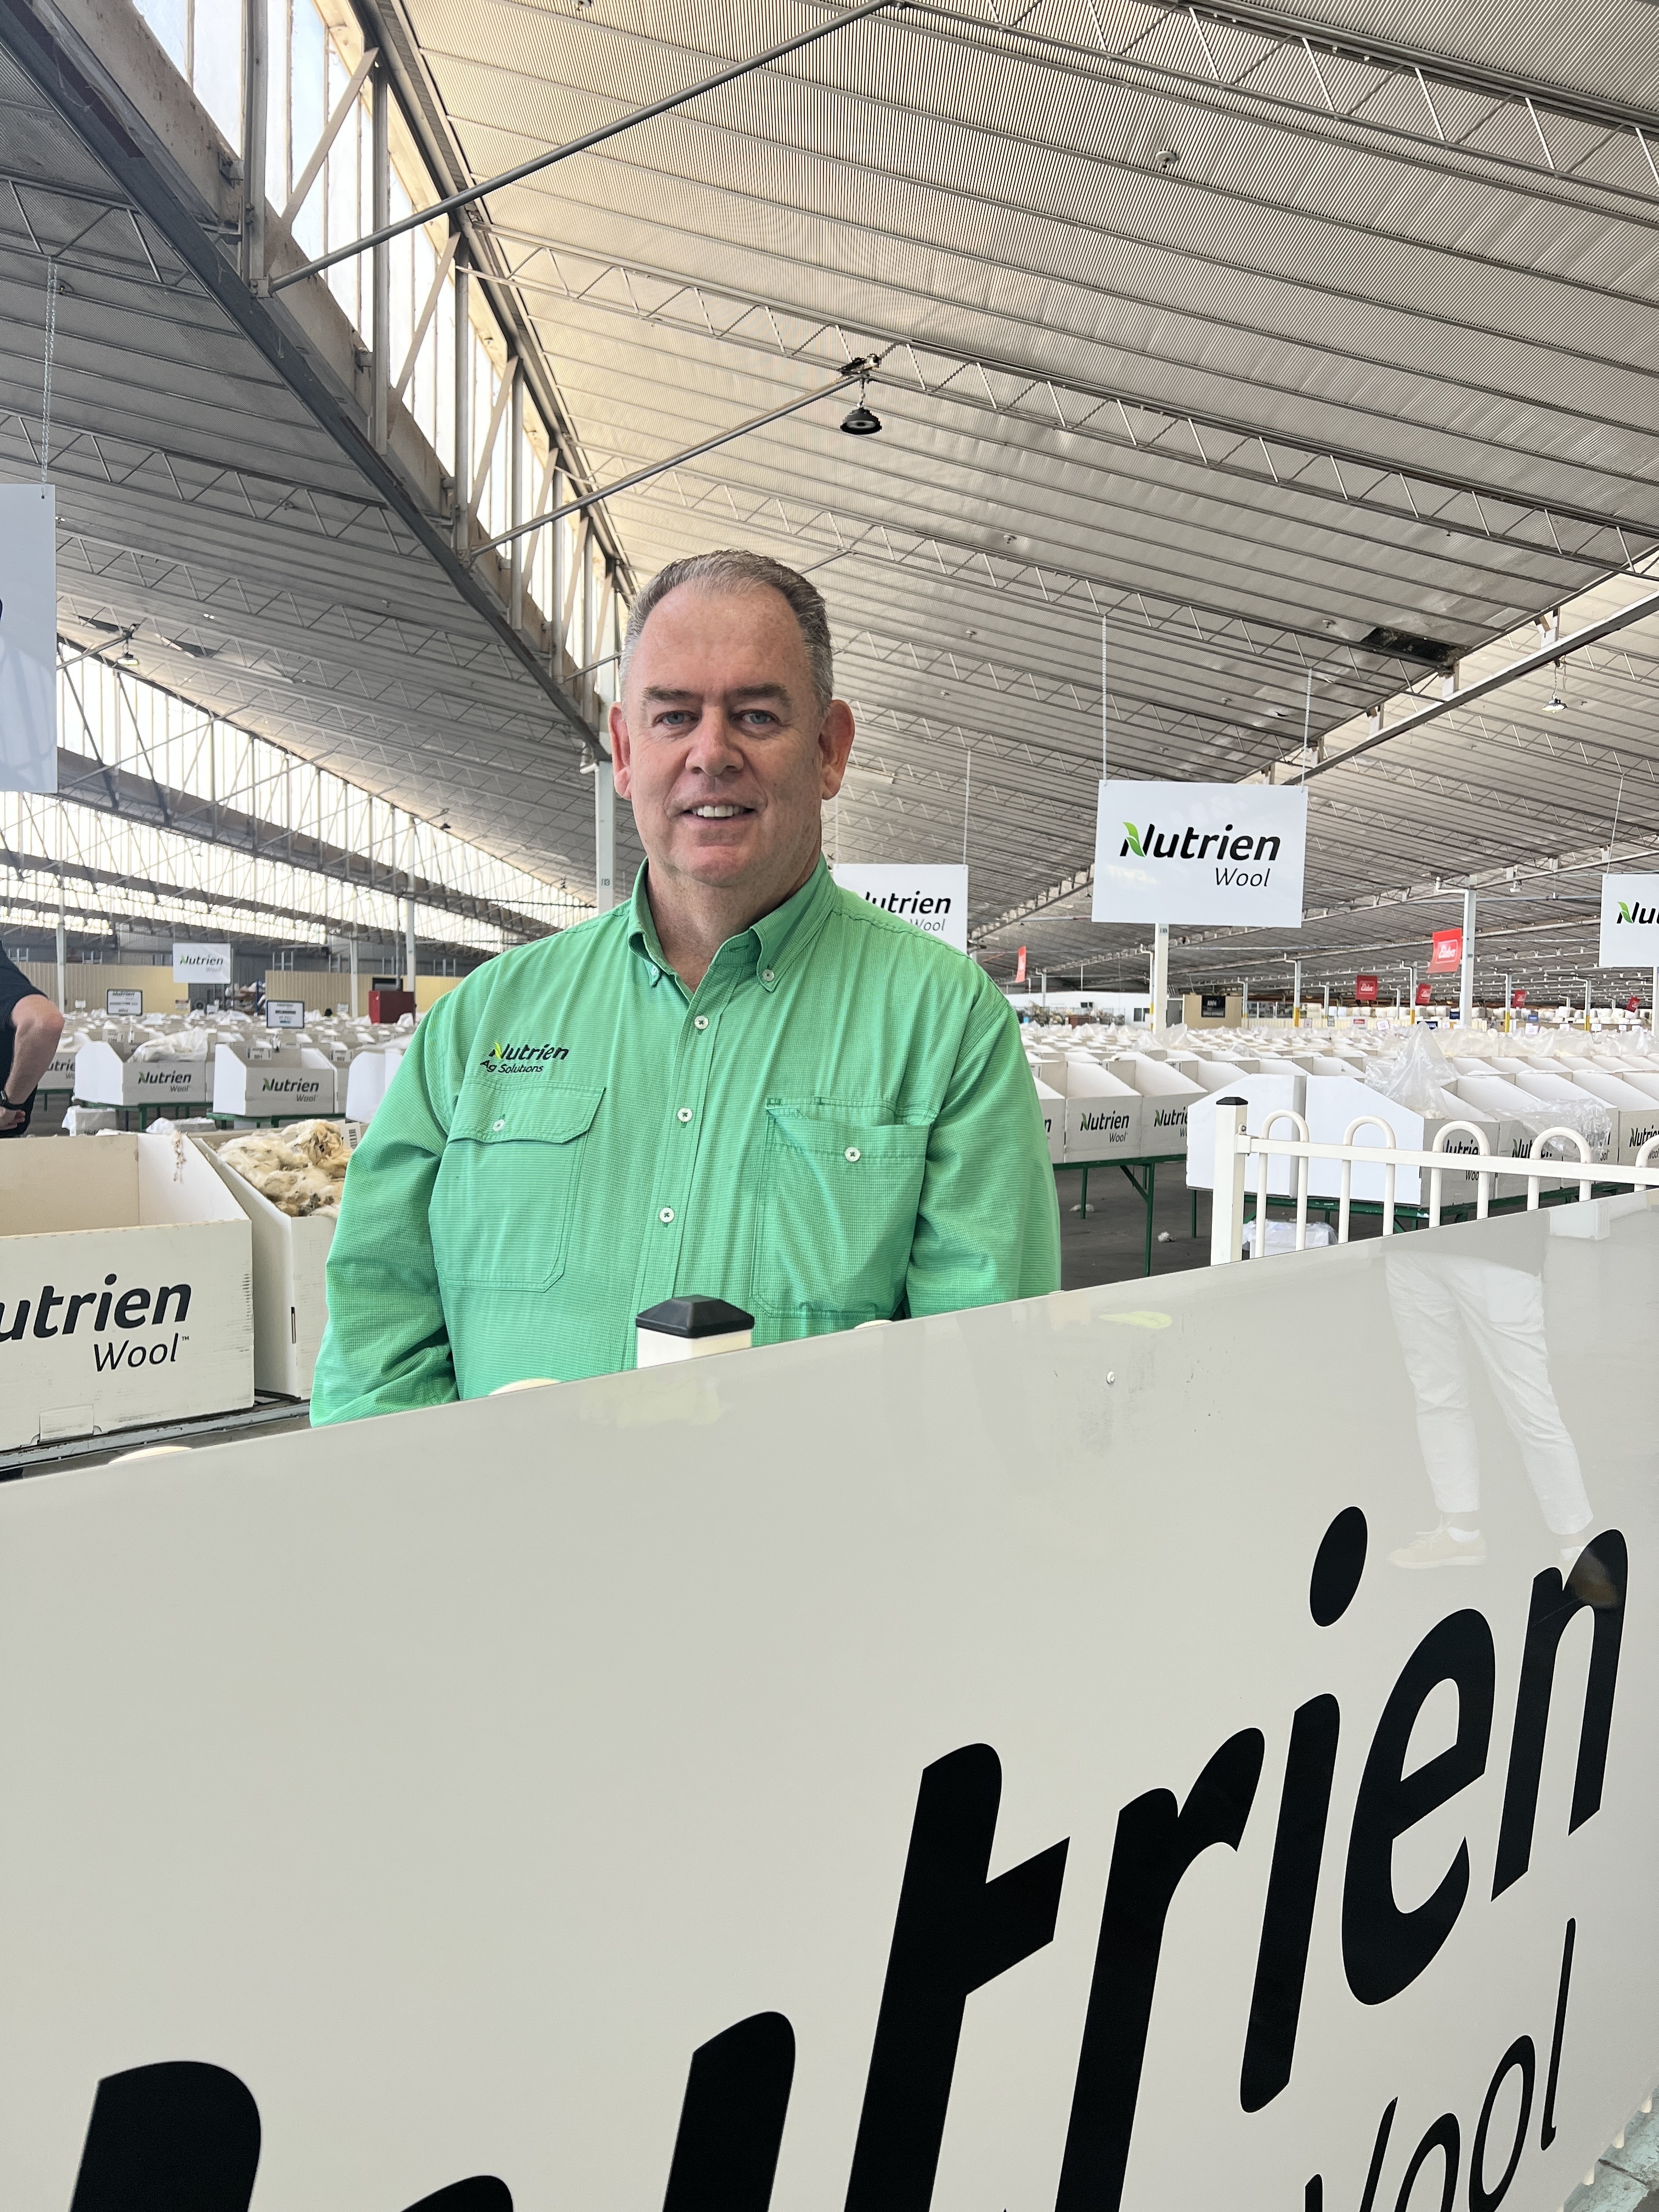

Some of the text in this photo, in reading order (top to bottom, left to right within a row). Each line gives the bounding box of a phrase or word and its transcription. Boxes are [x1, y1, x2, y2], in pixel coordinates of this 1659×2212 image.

[1120, 821, 1281, 861] Nutrien
[1215, 867, 1271, 887] Wool
[180, 954, 224, 966] Nutrien
[488, 1042, 569, 1060] Nutrien
[138, 1070, 192, 1084] Nutrien
[480, 1060, 544, 1074] Ag Solutions
[262, 1077, 319, 1093] Nutrien
[1080, 1110, 1130, 1132] Nutrien
[1154, 1106, 1187, 1127] Nutri
[1109, 1132, 1127, 1143] Wool
[1629, 1124, 1659, 1148] Nutri
[1465, 1169, 1480, 1181] Woo
[0, 1273, 191, 1343] utrien
[94, 1332, 179, 1372] Wool
[68, 1506, 1628, 2212] trien
